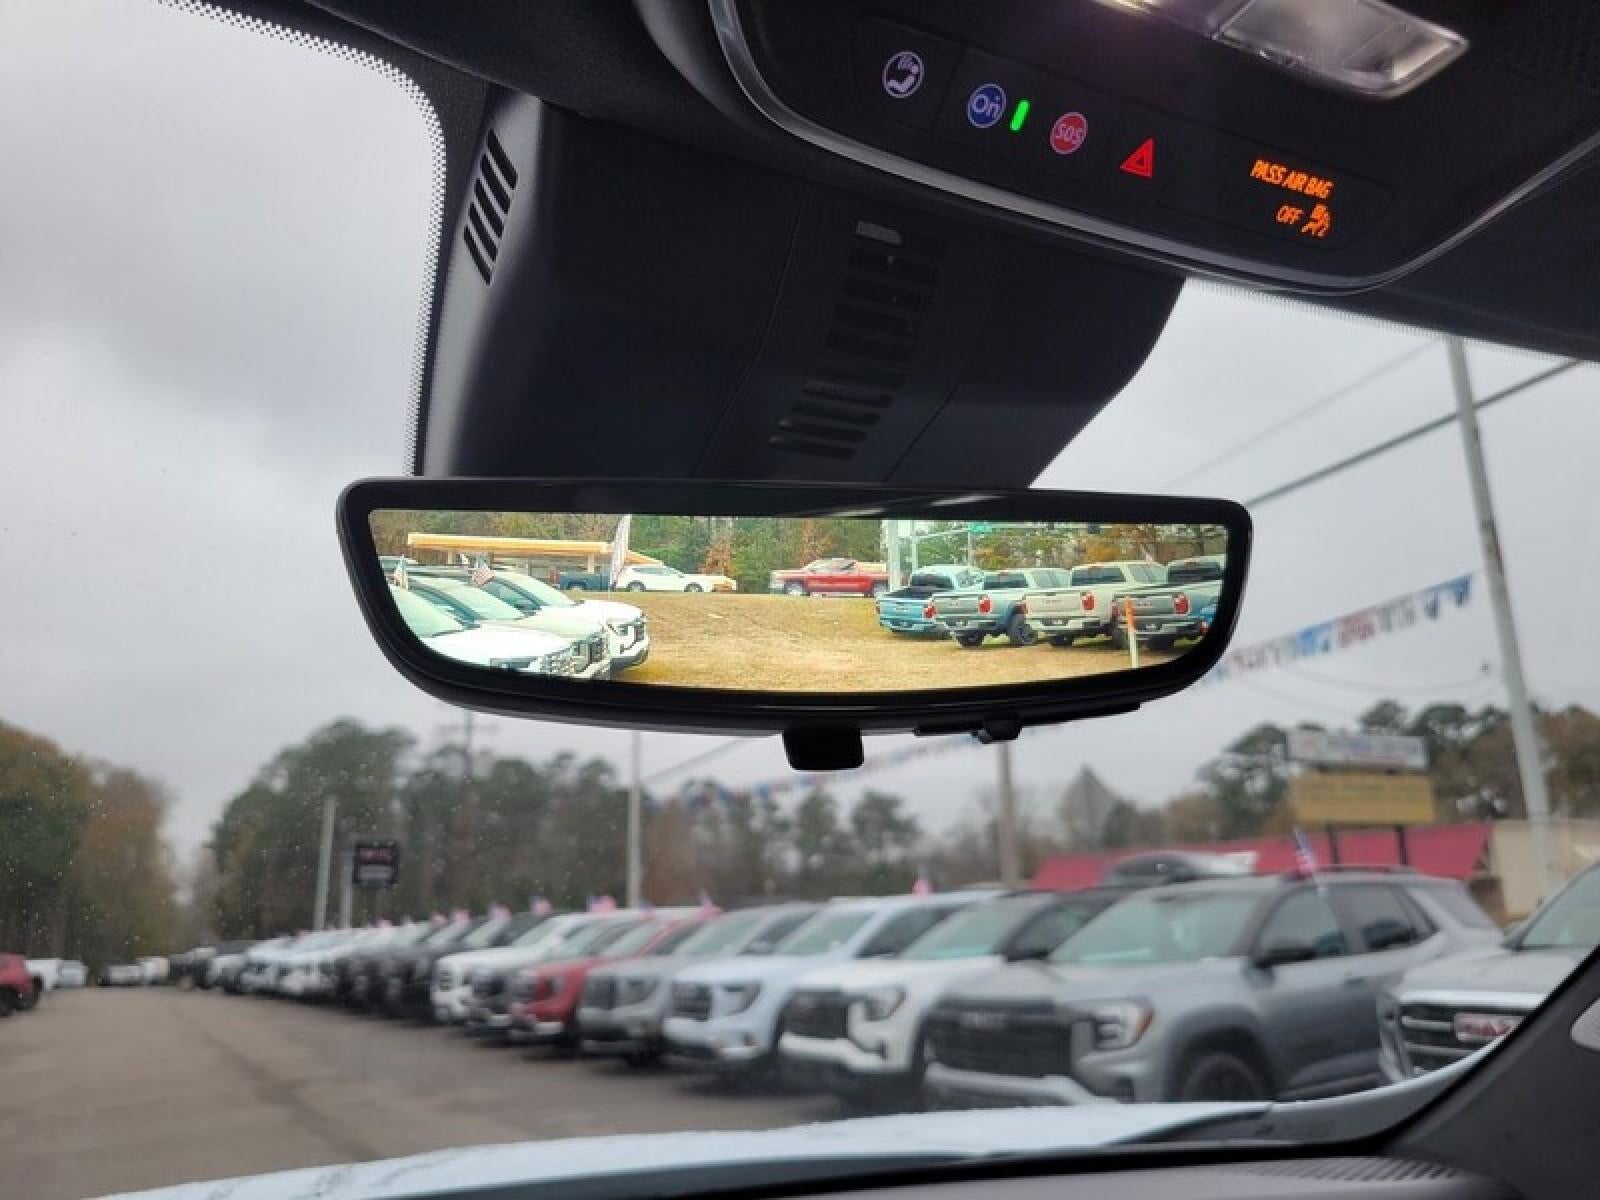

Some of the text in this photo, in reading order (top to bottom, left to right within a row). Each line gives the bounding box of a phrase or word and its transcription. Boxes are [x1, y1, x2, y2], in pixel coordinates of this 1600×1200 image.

[1054, 124, 1085, 145] SOS
[1251, 160, 1333, 198] PASS AIR BAG
[1276, 206, 1304, 225] OFF
